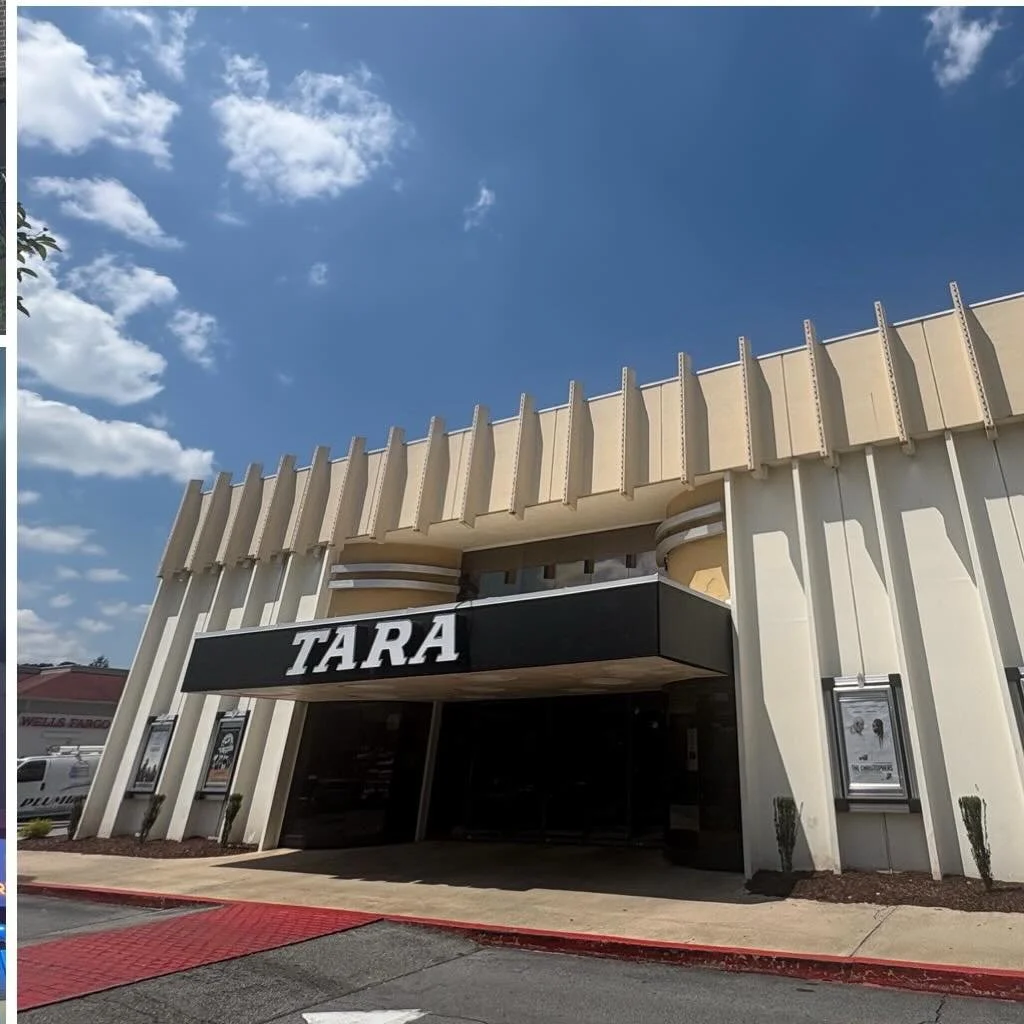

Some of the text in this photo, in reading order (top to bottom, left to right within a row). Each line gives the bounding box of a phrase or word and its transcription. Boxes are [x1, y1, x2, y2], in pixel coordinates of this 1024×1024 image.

[286, 613, 460, 676] TARA
[19, 715, 111, 729] WELLS FARGO
